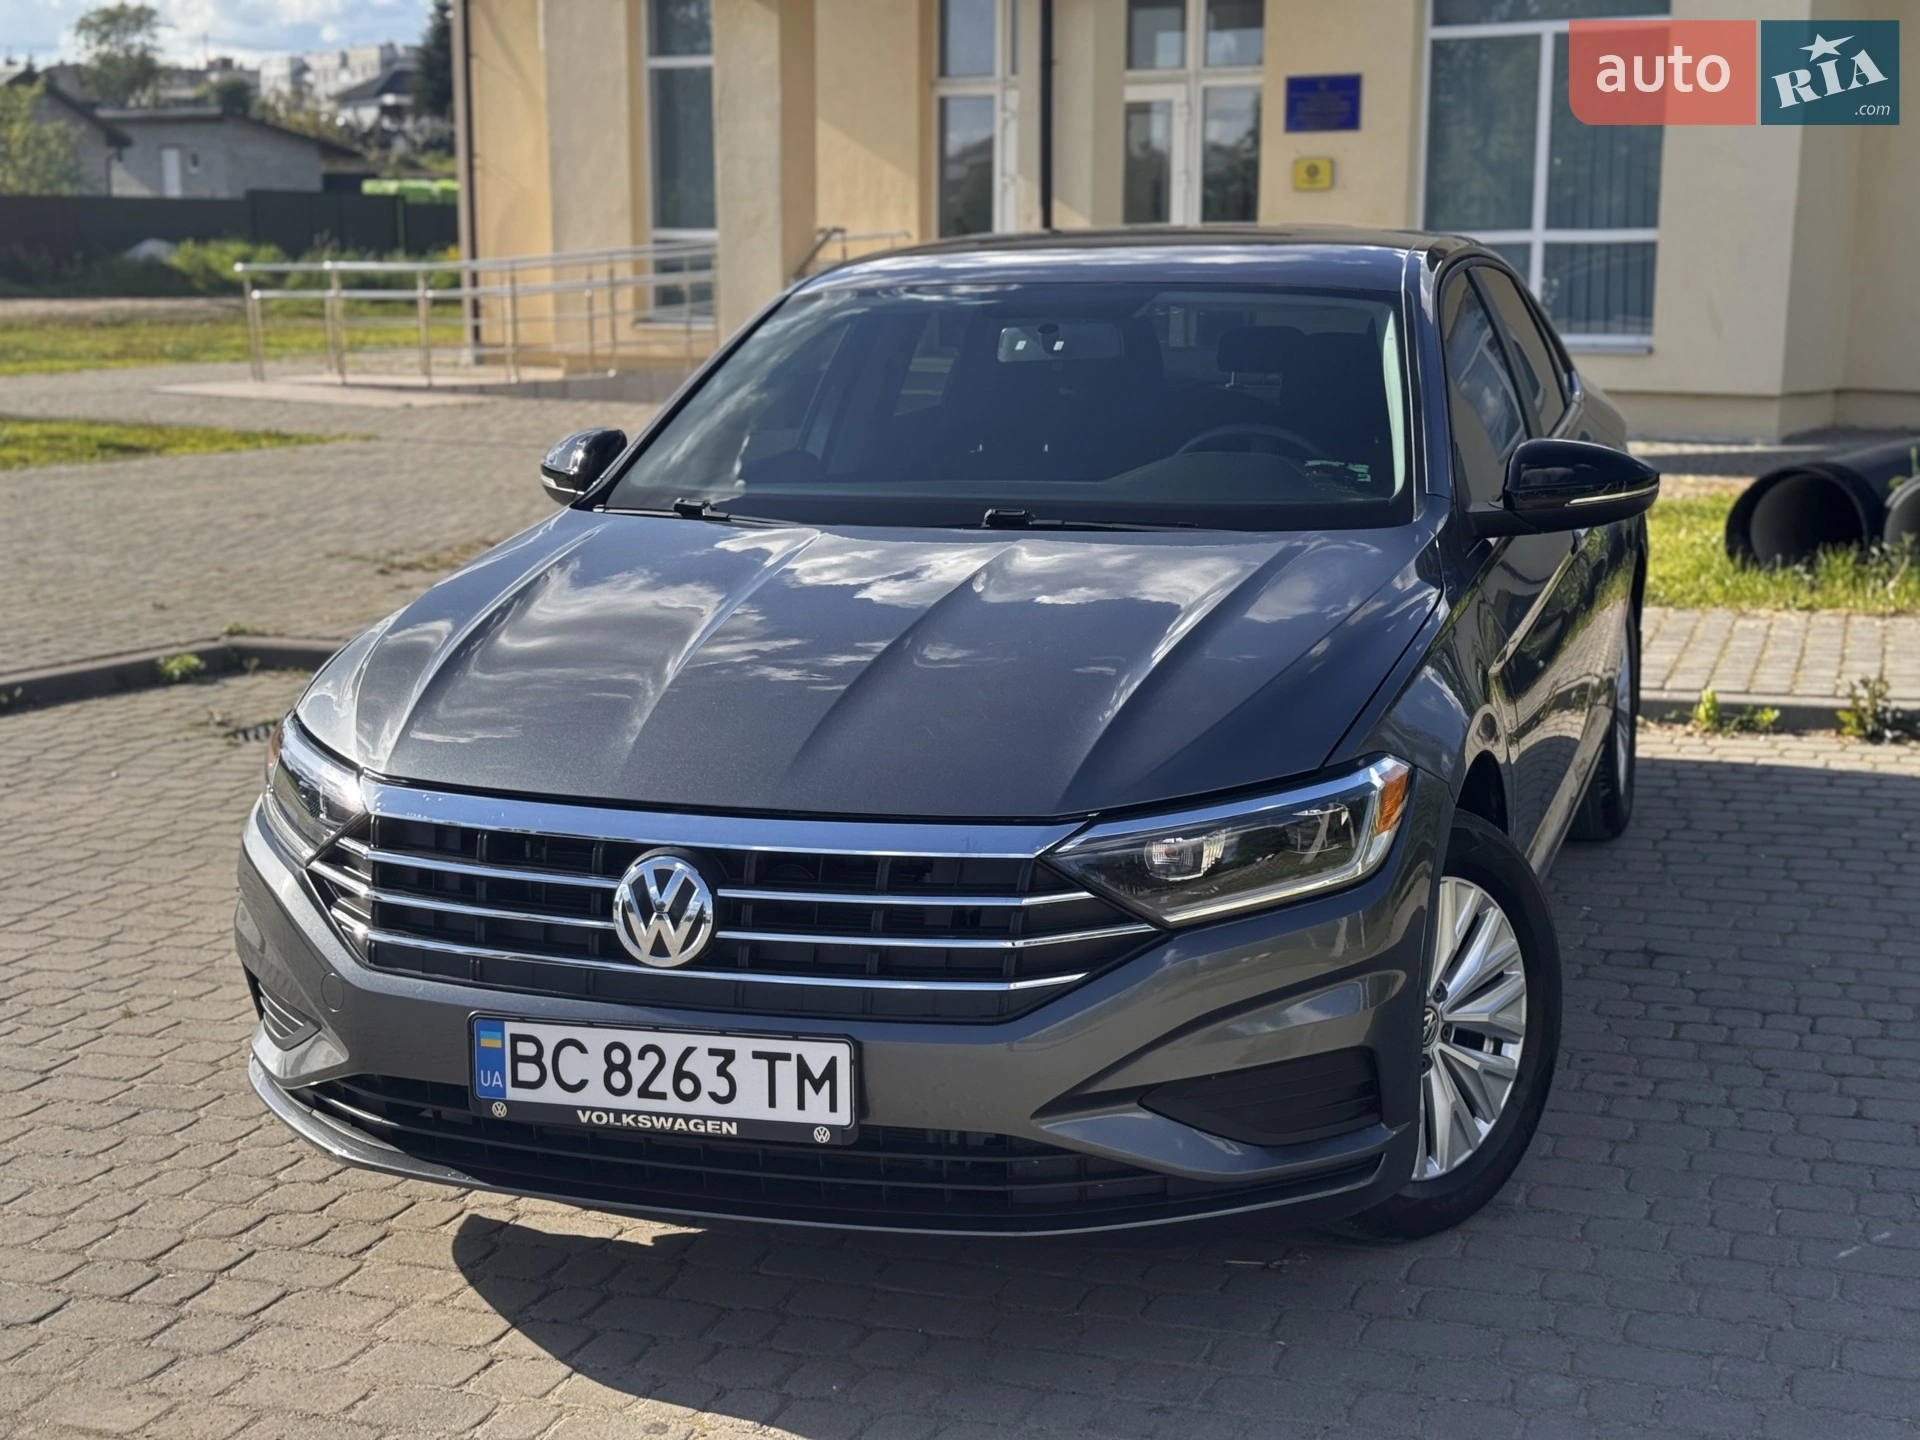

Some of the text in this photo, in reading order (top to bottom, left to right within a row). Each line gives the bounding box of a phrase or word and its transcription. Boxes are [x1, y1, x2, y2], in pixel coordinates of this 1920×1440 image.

[480, 1070, 504, 1089] UA
[509, 1033, 838, 1114] BC 8263 TM
[576, 1109, 739, 1136] VOLKSWAGEN
